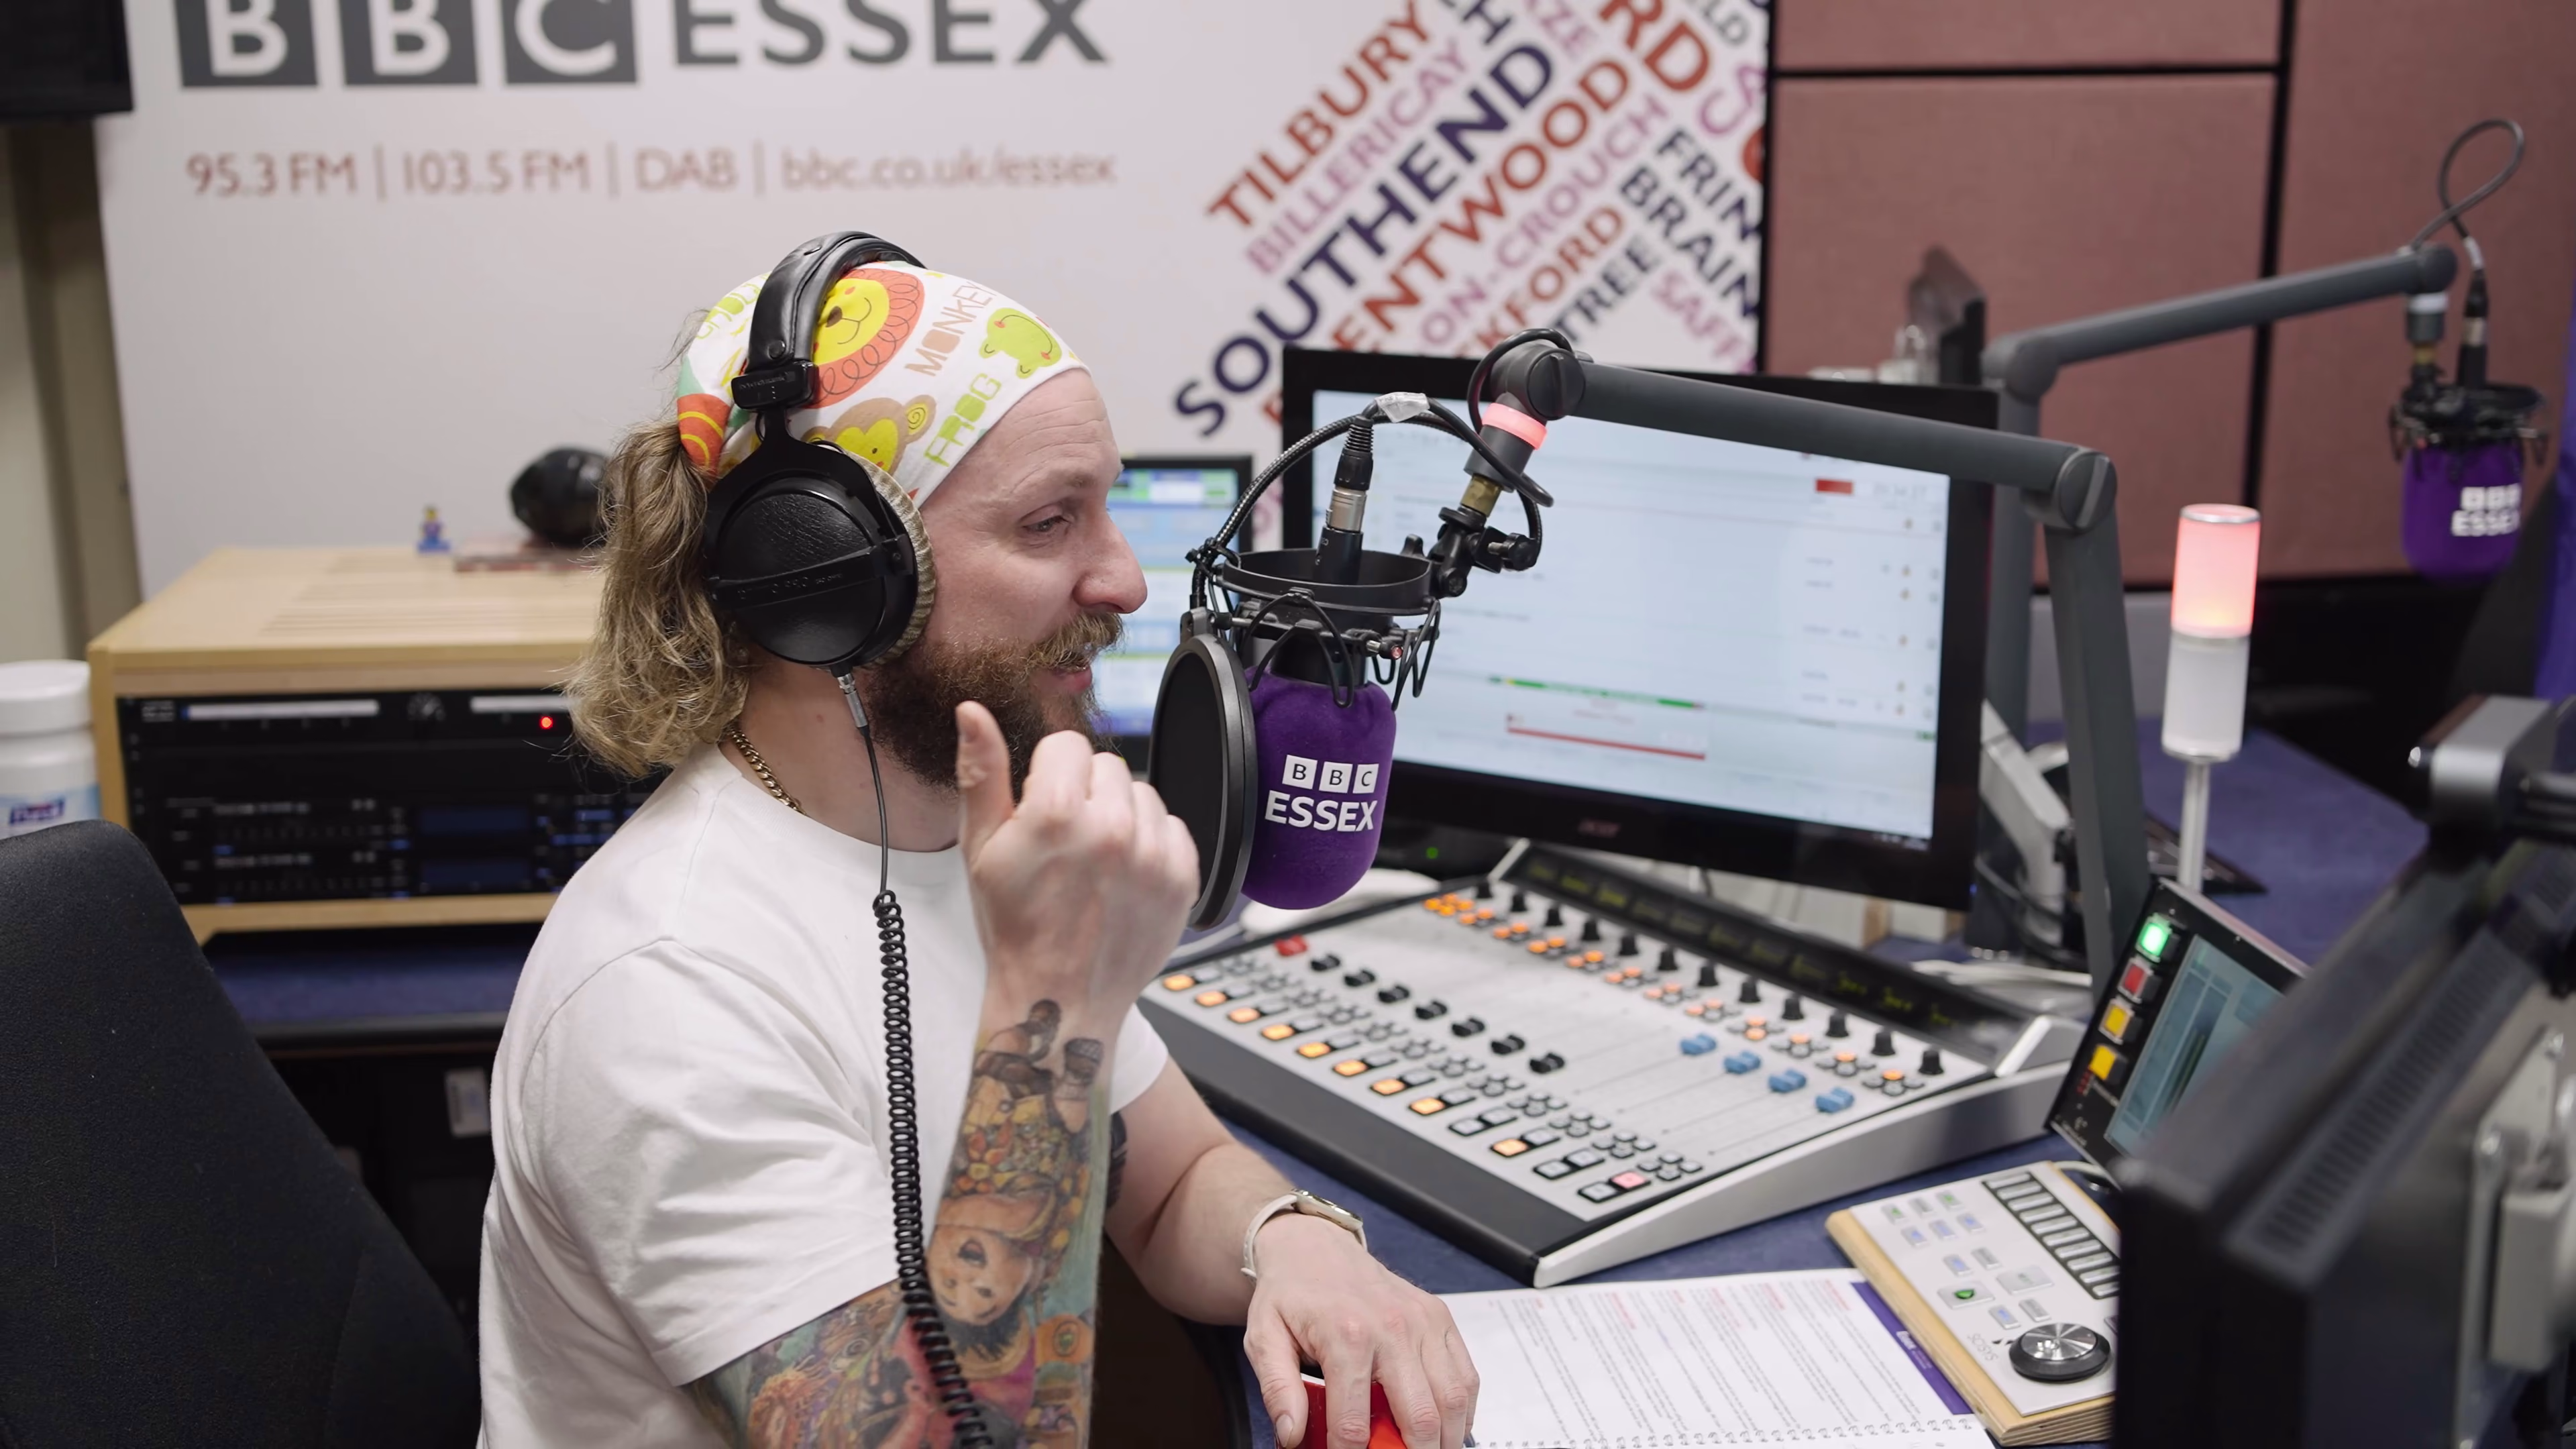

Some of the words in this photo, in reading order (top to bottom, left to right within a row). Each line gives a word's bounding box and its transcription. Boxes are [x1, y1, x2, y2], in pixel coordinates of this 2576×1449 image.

[184, 0, 627, 82] BBC
[673, 0, 1108, 65] ESSEX
[1208, 0, 1428, 227] TILBURY
[1246, 38, 1468, 275] BILLERICAY
[186, 154, 277, 195] 95.3
[290, 153, 358, 194] FM
[402, 150, 512, 195] 103.5
[523, 152, 590, 193] FM
[635, 146, 738, 191] DAB
[780, 144, 1117, 191] bbc.co.uk/essex
[1421, 94, 1669, 345] ON-CROUCH
[1656, 130, 1762, 241] FRIN
[1174, 44, 1552, 437] SOUTHEND
[1265, 60, 1629, 427] ENTWOOD
[1454, 206, 1626, 356] KFORD
[1545, 235, 1661, 343] TREE
[1620, 166, 1761, 318] BRAIN
[905, 282, 997, 376] MONKEY
[924, 372, 1002, 467] FROG
[1265, 790, 1377, 832] ESSEX
[1287, 759, 1376, 790] BBC
